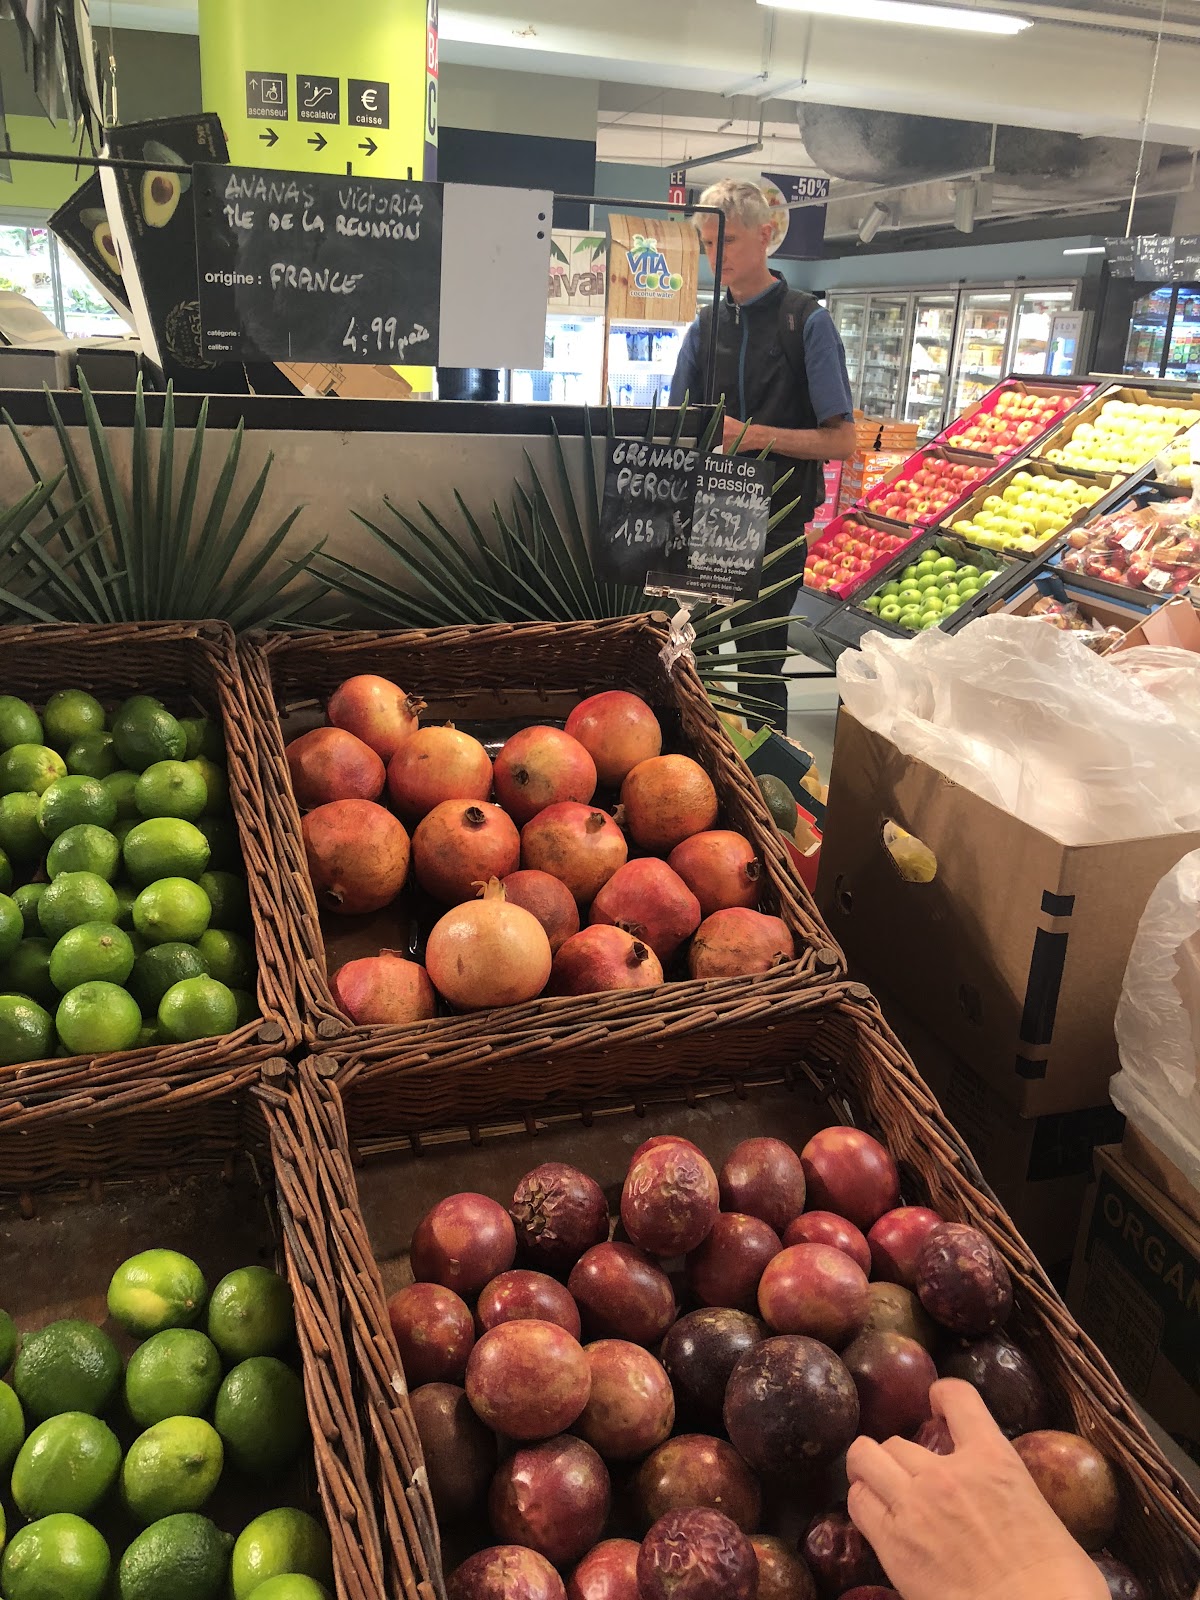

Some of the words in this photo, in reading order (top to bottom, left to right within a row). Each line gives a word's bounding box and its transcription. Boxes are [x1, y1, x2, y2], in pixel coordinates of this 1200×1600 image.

[248, 107, 287, 117] ascenseur
[301, 109, 337, 120] escalator
[356, 114, 382, 125] caisse
[224, 174, 315, 208] ANANAS
[792, 178, 827, 197] -50%
[269, 212, 294, 231] DE
[302, 210, 325, 233] LA
[626, 251, 670, 275] VITA
[205, 270, 254, 285] origine
[270, 262, 363, 294] FRANCE
[635, 271, 683, 291] COCO
[631, 290, 656, 299] coconut
[207, 330, 237, 338] catégorie
[208, 343, 229, 351] calibre
[613, 442, 699, 473] GRENADE
[705, 456, 734, 475] fruit
[737, 462, 756, 478] de
[708, 476, 765, 496] passion
